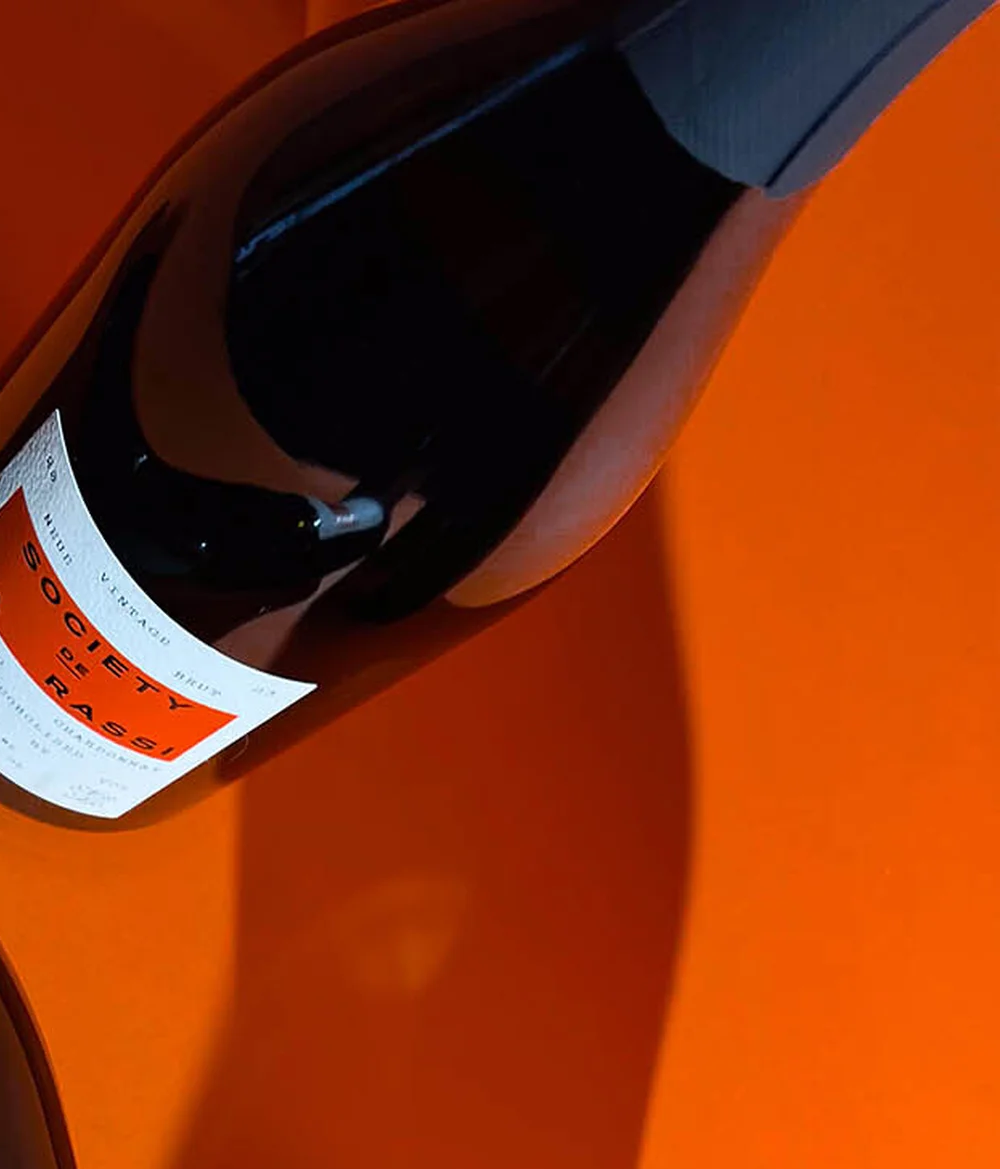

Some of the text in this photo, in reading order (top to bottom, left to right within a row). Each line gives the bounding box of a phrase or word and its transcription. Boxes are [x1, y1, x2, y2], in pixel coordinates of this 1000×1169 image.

[23, 541, 196, 710] SOCIETY
[59, 646, 90, 677] DE
[44, 674, 176, 756] RASSI
